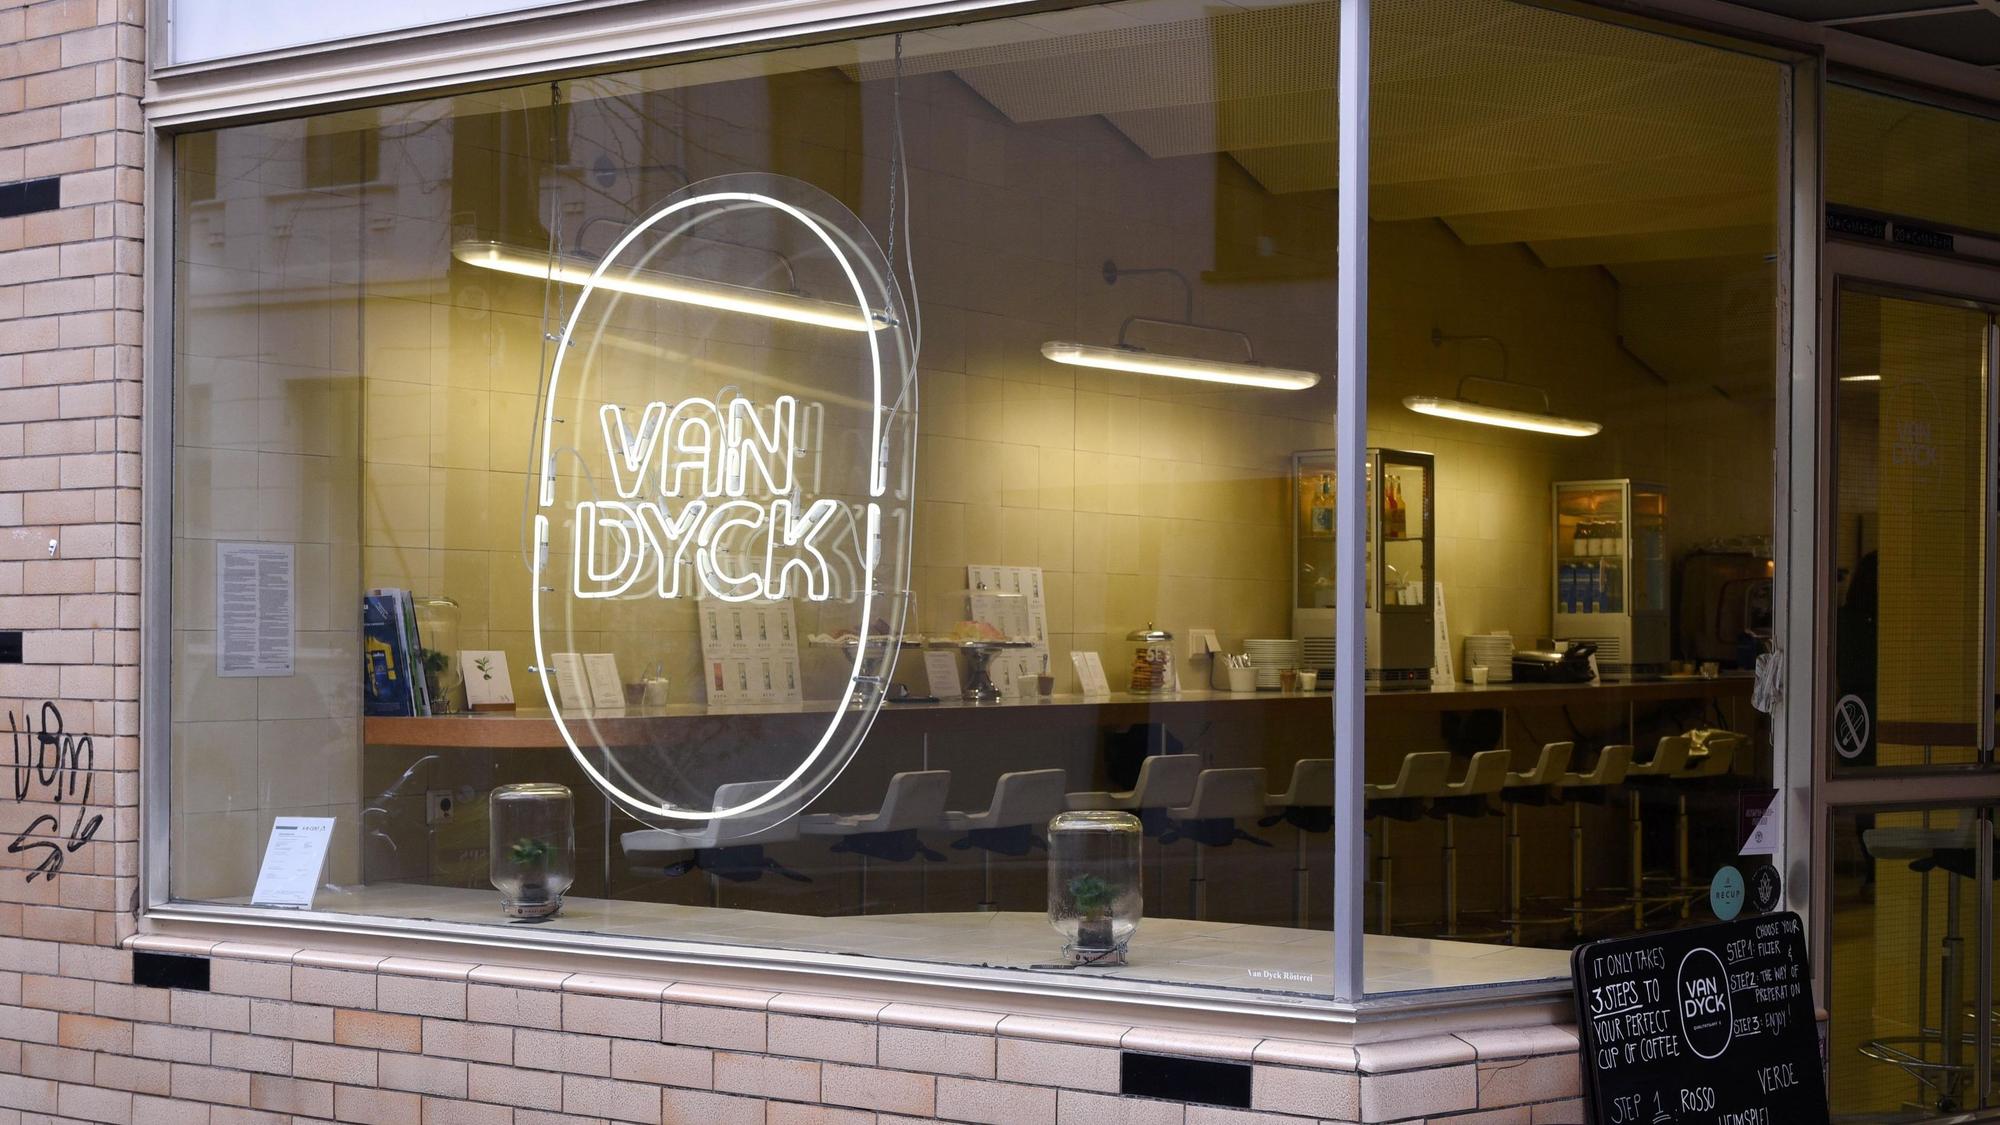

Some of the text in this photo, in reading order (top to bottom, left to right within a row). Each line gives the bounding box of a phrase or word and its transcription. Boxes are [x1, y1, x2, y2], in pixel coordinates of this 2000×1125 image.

[599, 395, 796, 498] VAN
[573, 499, 837, 602] DYCK
[1716, 889, 1740, 899] RECUP
[1755, 919, 1800, 939] CHOOSE YOUR
[1757, 940, 1781, 957] FILTER
[1247, 968, 1313, 982] Van Dyck Rösterei
[1593, 946, 1665, 979] IT ONLY TAKES
[1760, 969, 1773, 983] THE
[1773, 964, 1787, 981] WAY
[1790, 964, 1799, 978] OF
[1643, 978, 1660, 1004] TO
[1685, 976, 1717, 998] VAN
[1755, 982, 1801, 1003] PREPERATON
[1684, 993, 1726, 1018] DYCK
[1593, 1009, 1671, 1045] YOUR PERFECT
[1598, 1035, 1680, 1070] CUP OF COFFEE
[1757, 1063, 1799, 1095] VERDE
[1611, 1093, 1641, 1124] STEP
[1680, 1087, 1715, 1113] ROSSO
